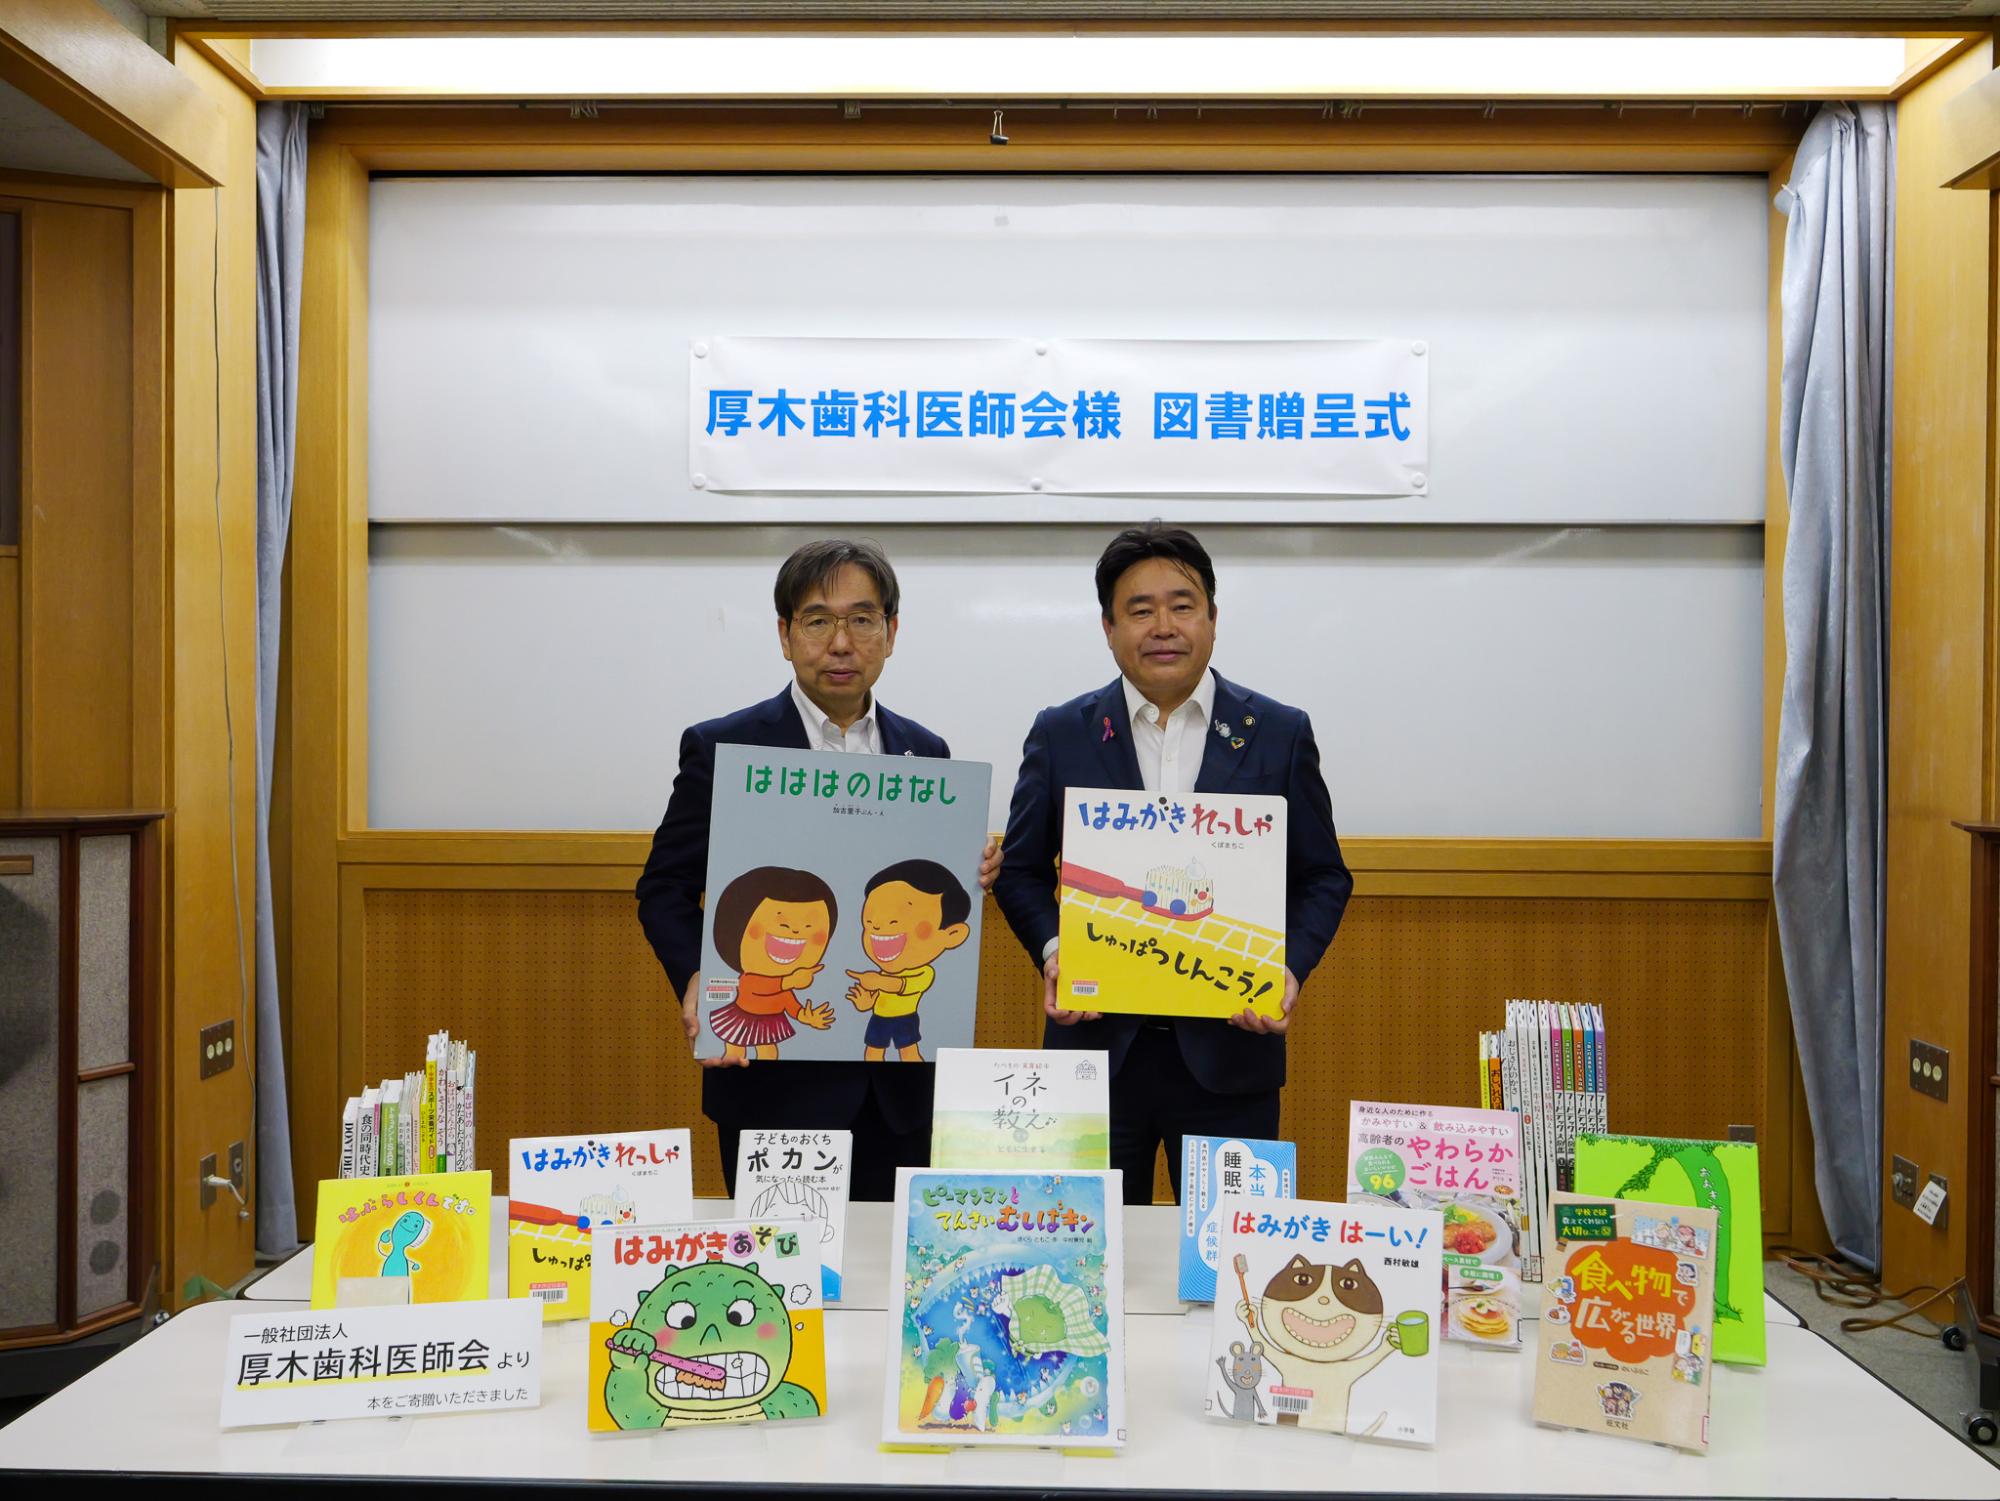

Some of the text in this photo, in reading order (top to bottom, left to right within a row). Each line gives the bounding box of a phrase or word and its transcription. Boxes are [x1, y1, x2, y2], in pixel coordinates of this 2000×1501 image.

[705, 387, 1411, 442] 厚木歯科医師会様 図書贈呈式
[745, 765, 956, 805] はははのはなし
[1507, 1039, 1519, 1096] おじさんのかさ
[993, 1071, 1048, 1096] イネ
[1012, 1096, 1027, 1107] の
[1358, 1106, 1434, 1118] 身近な人のために作る
[992, 1107, 1046, 1130] 教え
[1360, 1117, 1510, 1136] かみやすい & 飲み込みやすい
[359, 1114, 372, 1177] 食の同時代史
[753, 1132, 832, 1145] 子どものおくち
[1358, 1132, 1405, 1146] 高齢者の
[1407, 1136, 1514, 1164] やわらか
[755, 1174, 827, 1184] 気になったら読む本
[1369, 1174, 1396, 1190] 96
[1408, 1162, 1490, 1190] ごはん
[922, 1185, 1020, 1207] ピーマンマンと
[1205, 1222, 1218, 1262] 症候群
[1232, 1210, 1428, 1250] はみがき はーい!
[614, 1225, 800, 1266] はみがきあそび
[1383, 1257, 1420, 1269] 西村敏雄
[1571, 1250, 1689, 1307] 食べ物で
[243, 1322, 349, 1344] 一般社団法人
[1575, 1295, 1678, 1345] 広がる世界
[236, 1338, 531, 1387] 厚木歯科医師会 より
[367, 1386, 529, 1411] 本をご寄贈いただきました
